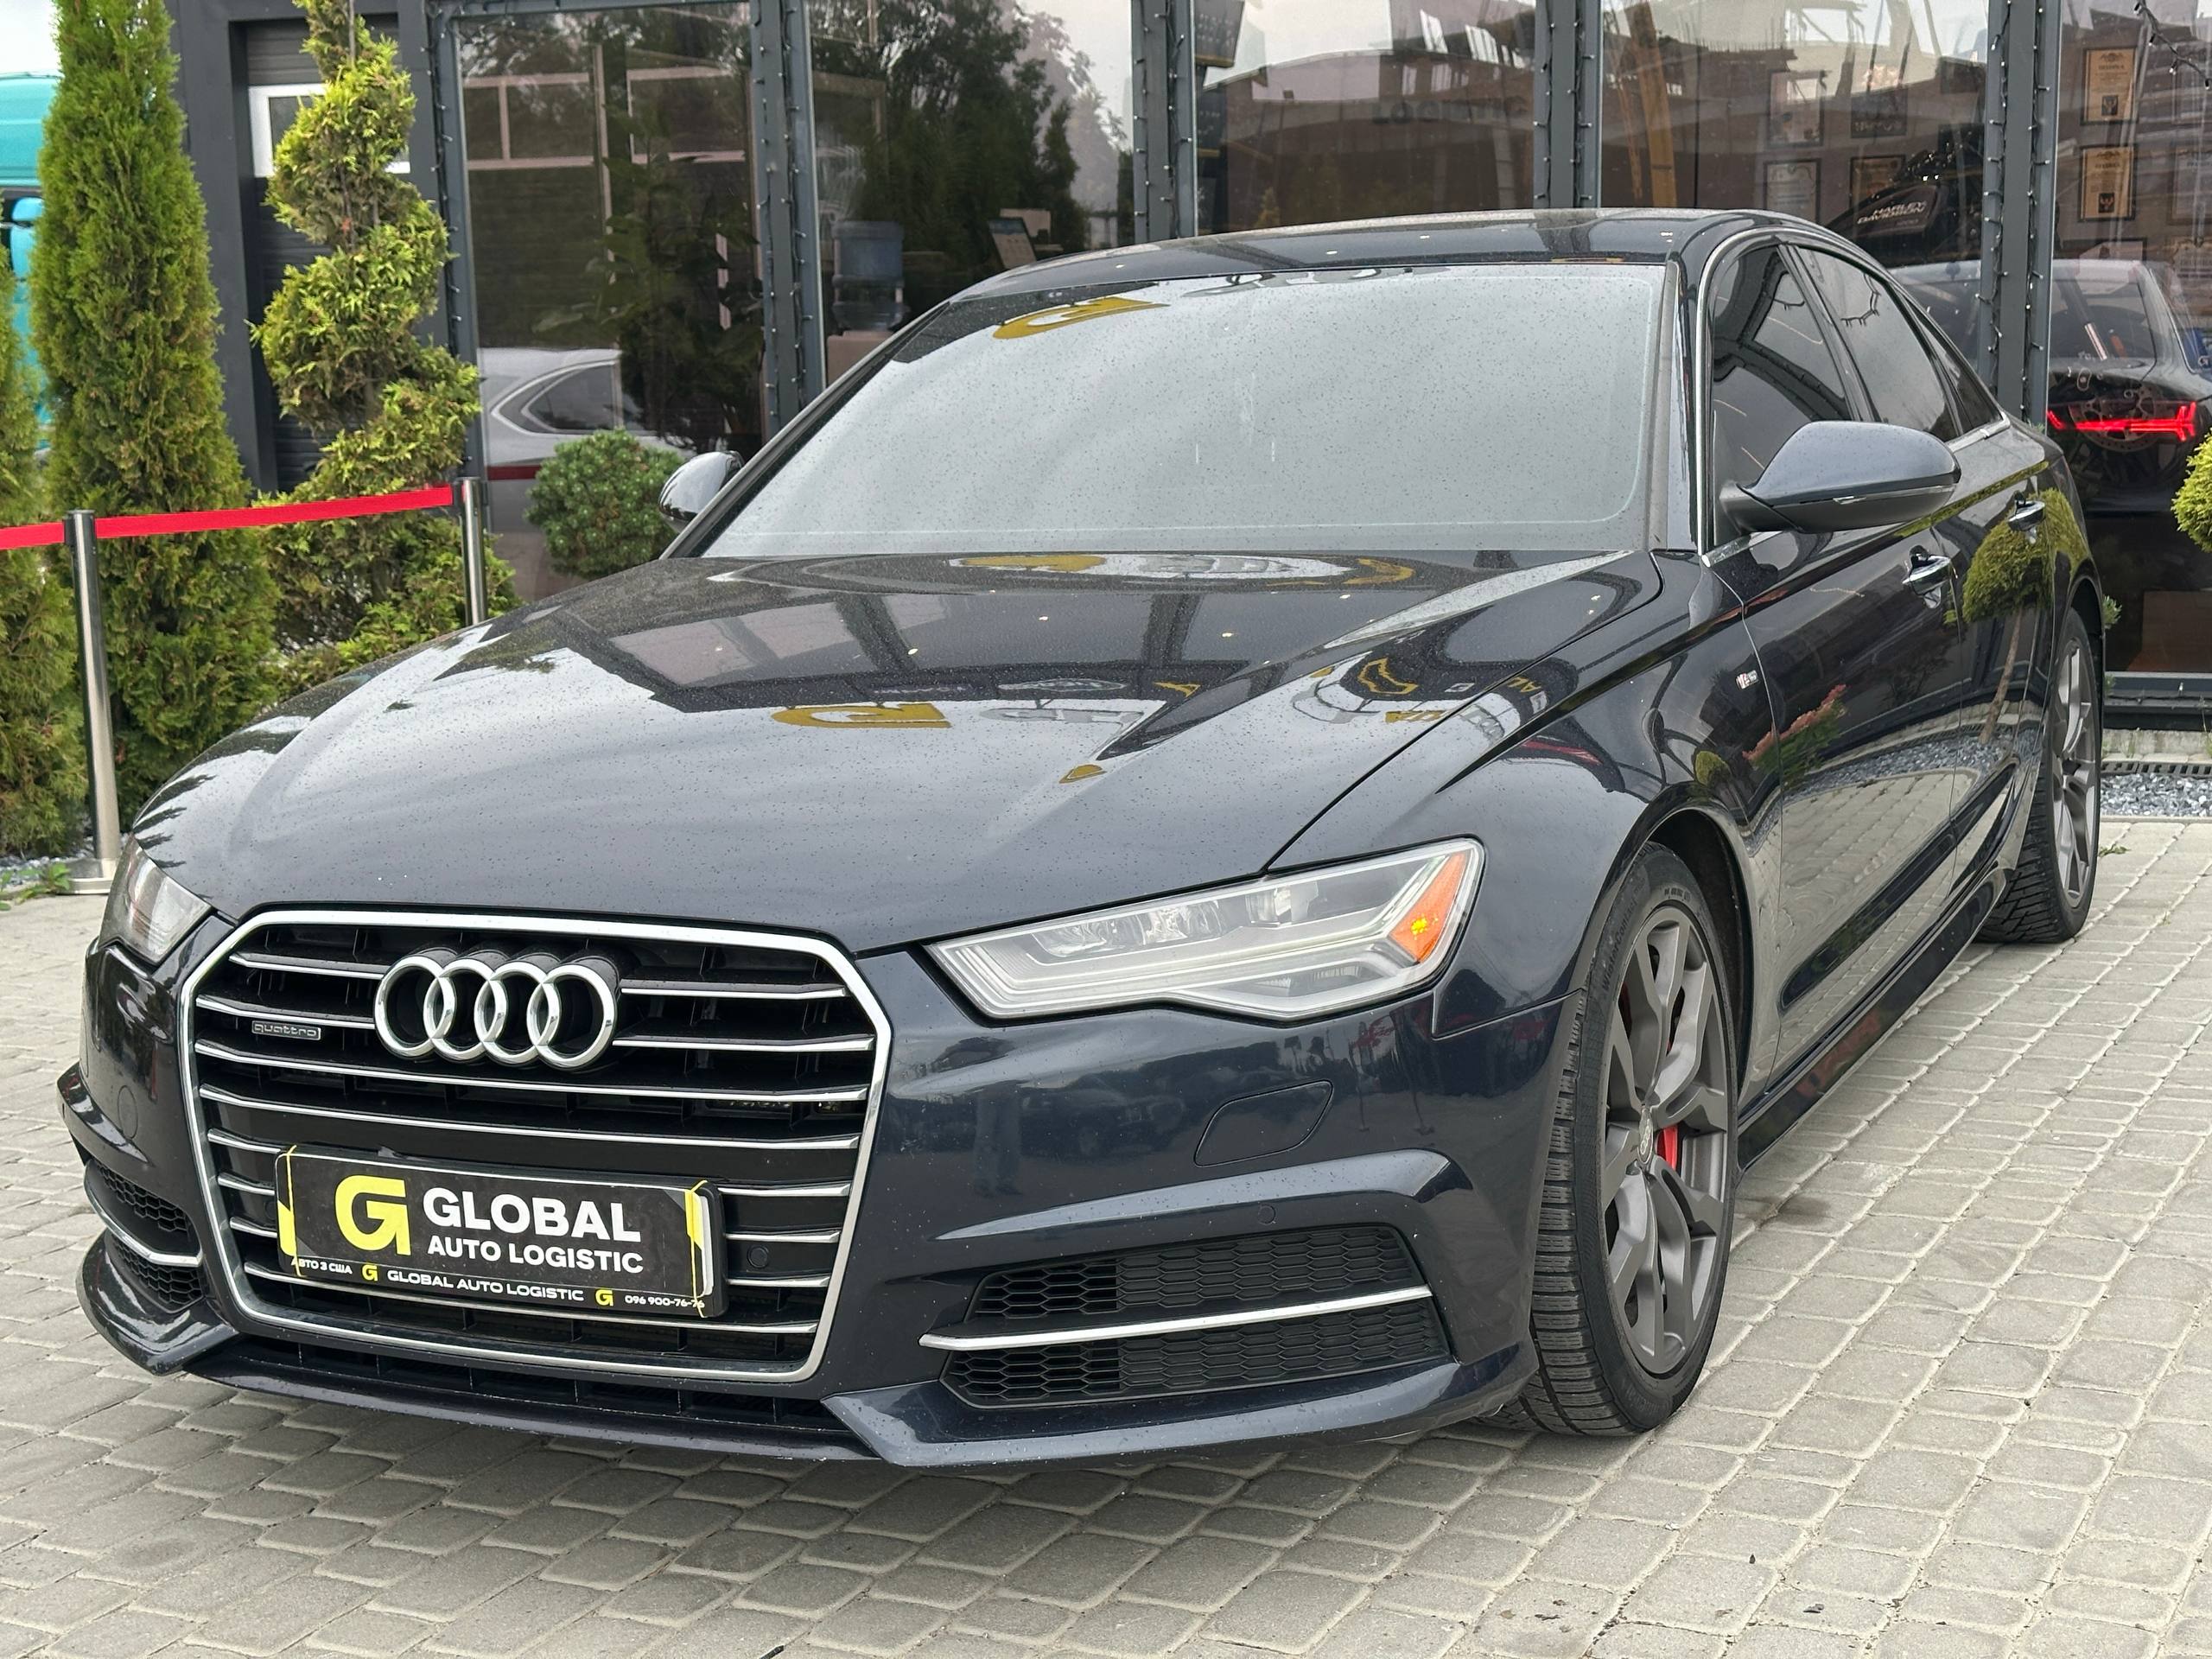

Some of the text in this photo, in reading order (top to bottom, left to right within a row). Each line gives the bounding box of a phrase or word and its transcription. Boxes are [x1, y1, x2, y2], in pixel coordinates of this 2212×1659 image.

[254, 1023, 317, 1037] quattro
[423, 1187, 642, 1243] GLOBAL
[427, 1235, 644, 1274] AUTO LOGISTIC
[328, 1262, 353, 1274] США
[387, 1269, 454, 1289] GLOBAL
[457, 1278, 504, 1294] AUTO
[506, 1283, 585, 1301] LOGISTIC
[625, 1294, 646, 1306] 096
